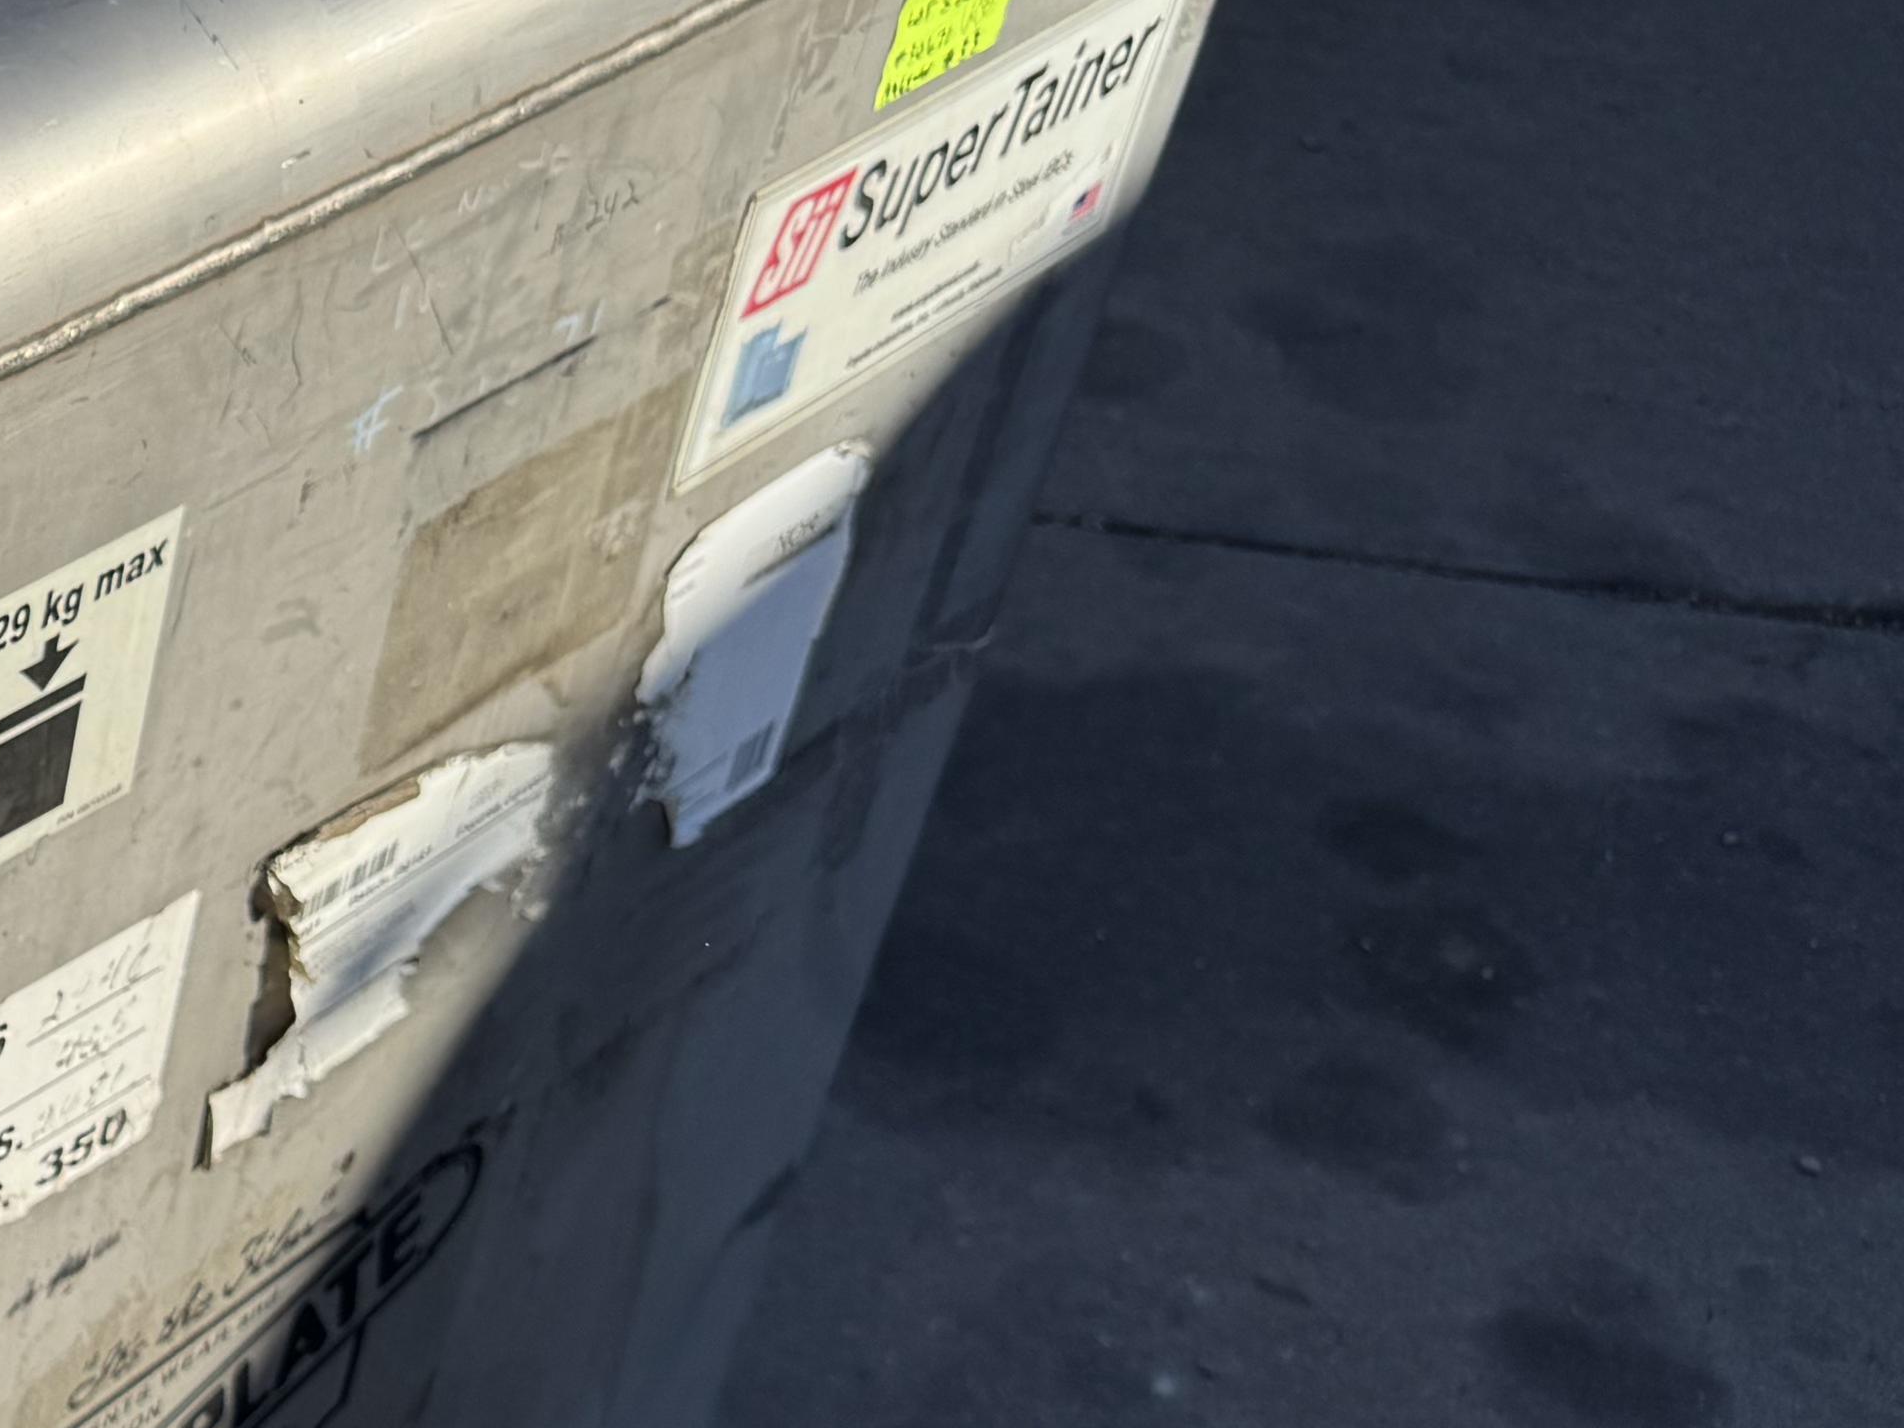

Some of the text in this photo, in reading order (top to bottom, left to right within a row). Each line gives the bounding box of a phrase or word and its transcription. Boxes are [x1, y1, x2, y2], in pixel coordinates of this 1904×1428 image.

[838, 16, 1162, 252] SuperTainer
[42, 583, 82, 629] kg
[93, 536, 170, 607] max
[35, 1107, 128, 1187] 350
